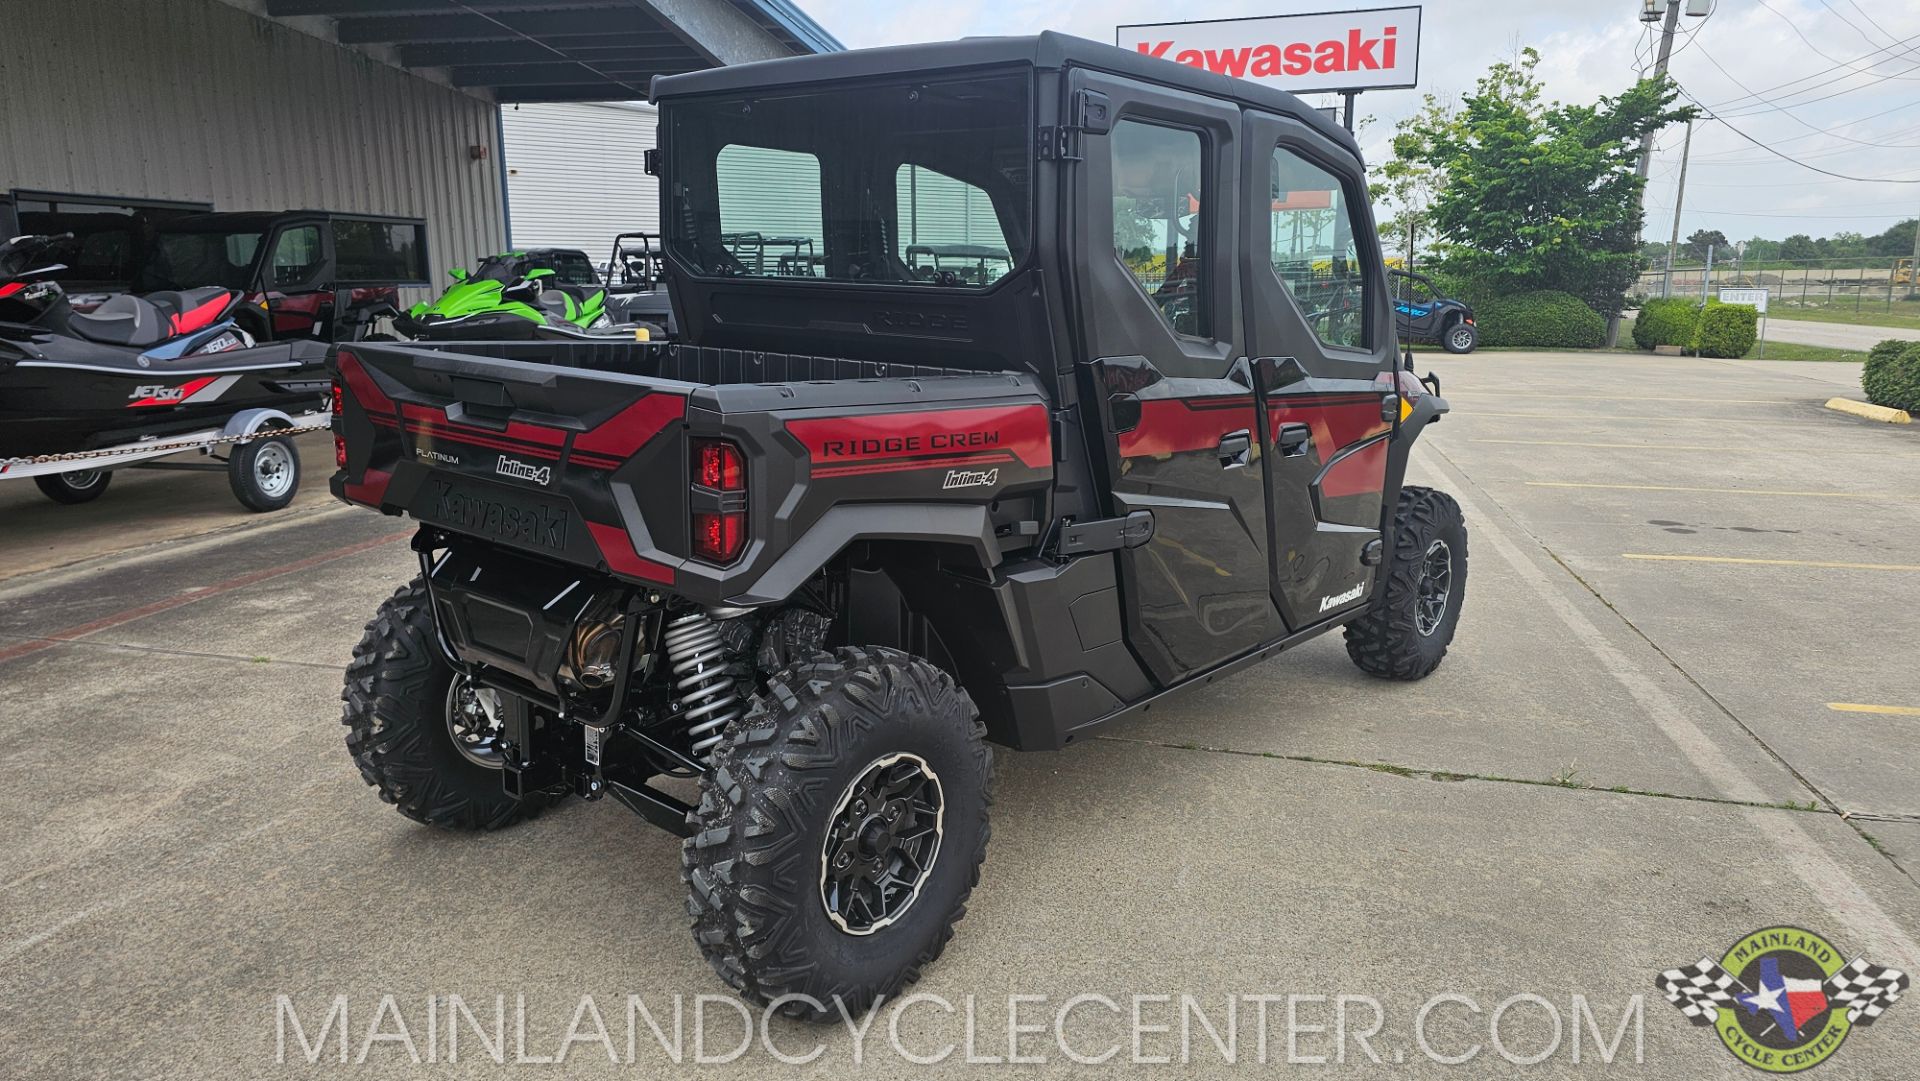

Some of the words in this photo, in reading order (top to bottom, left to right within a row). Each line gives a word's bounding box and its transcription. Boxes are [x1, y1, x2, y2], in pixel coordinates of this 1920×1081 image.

[1722, 292, 1763, 302] ENTER
[416, 448, 459, 465] PLATINUM
[823, 436, 920, 457] RIDGE
[931, 431, 999, 449] CREW
[496, 454, 551, 486] Inline-4
[942, 467, 999, 490] Inline-4
[433, 479, 569, 551] Kawasaki
[1319, 581, 1365, 613] Kawasaki
